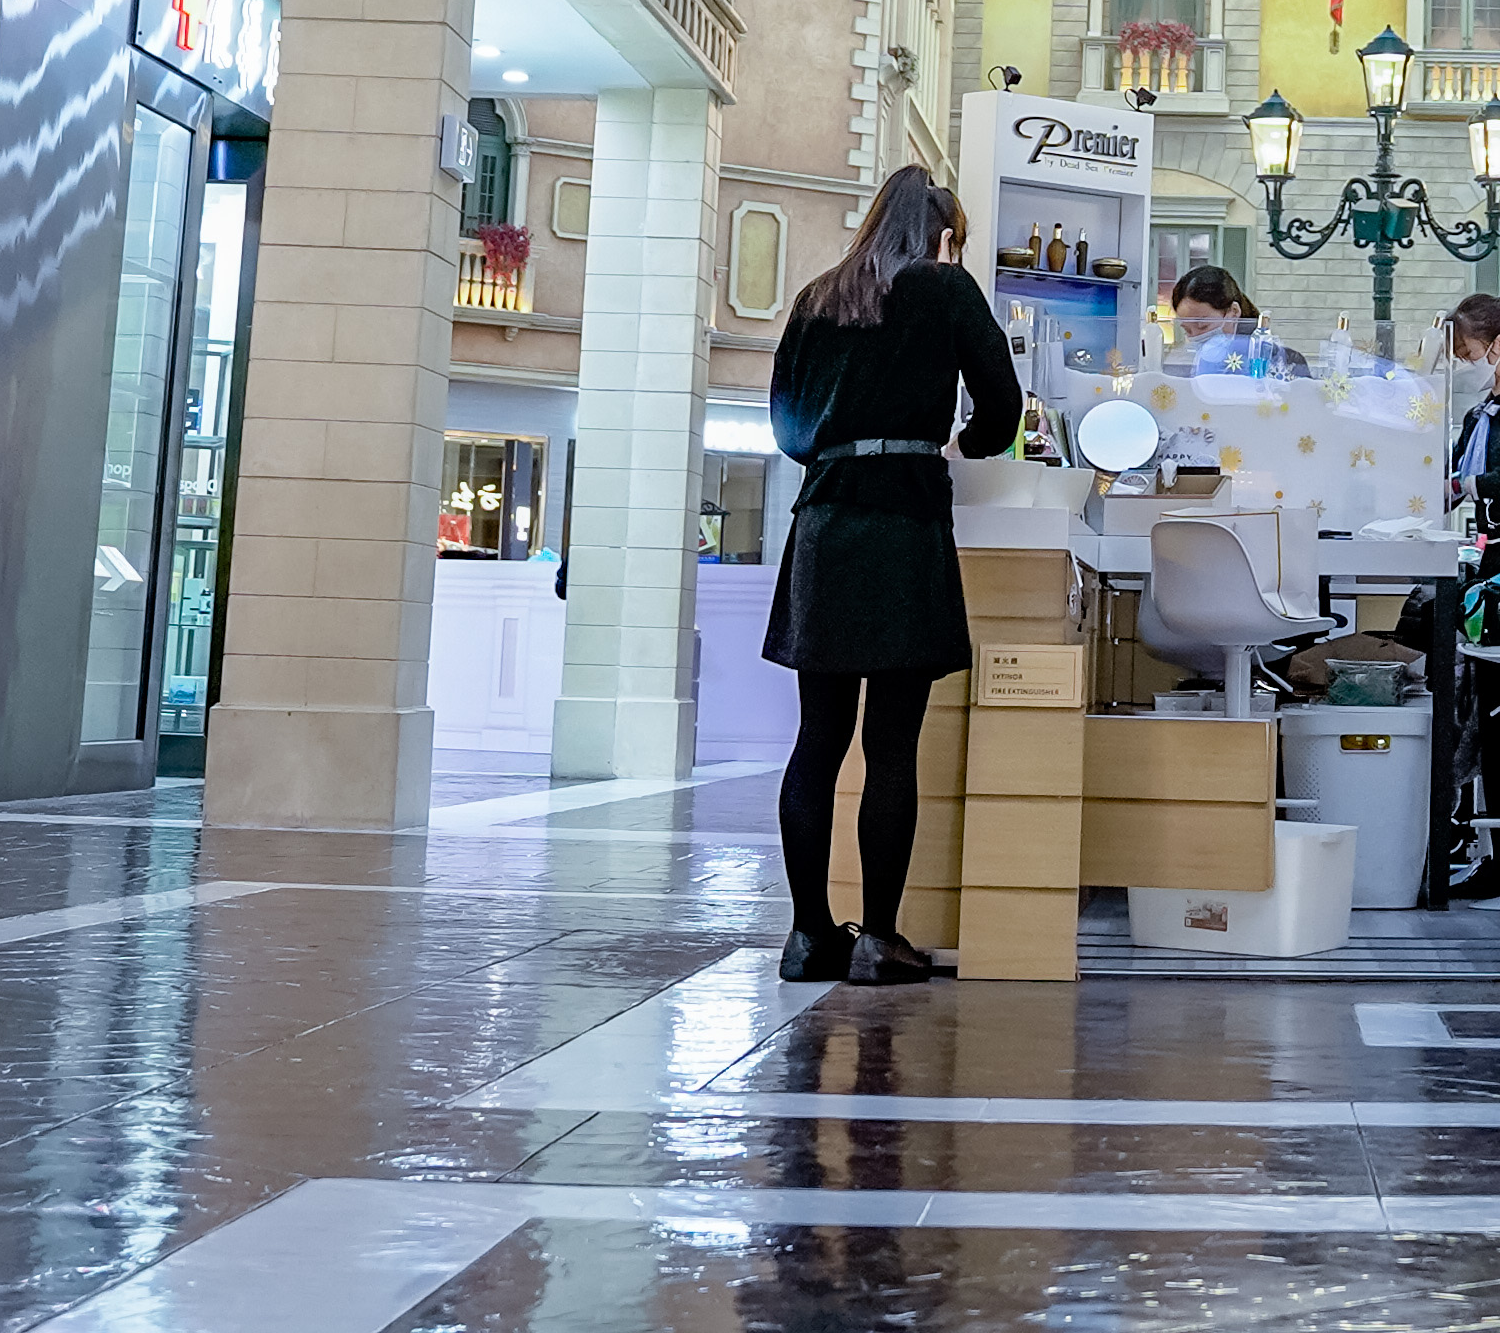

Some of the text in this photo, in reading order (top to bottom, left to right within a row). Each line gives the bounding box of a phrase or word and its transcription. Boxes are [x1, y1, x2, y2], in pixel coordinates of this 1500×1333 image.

[1012, 116, 1139, 164] Premier
[1059, 158, 1080, 170] Dead
[1084, 161, 1099, 173] Sea
